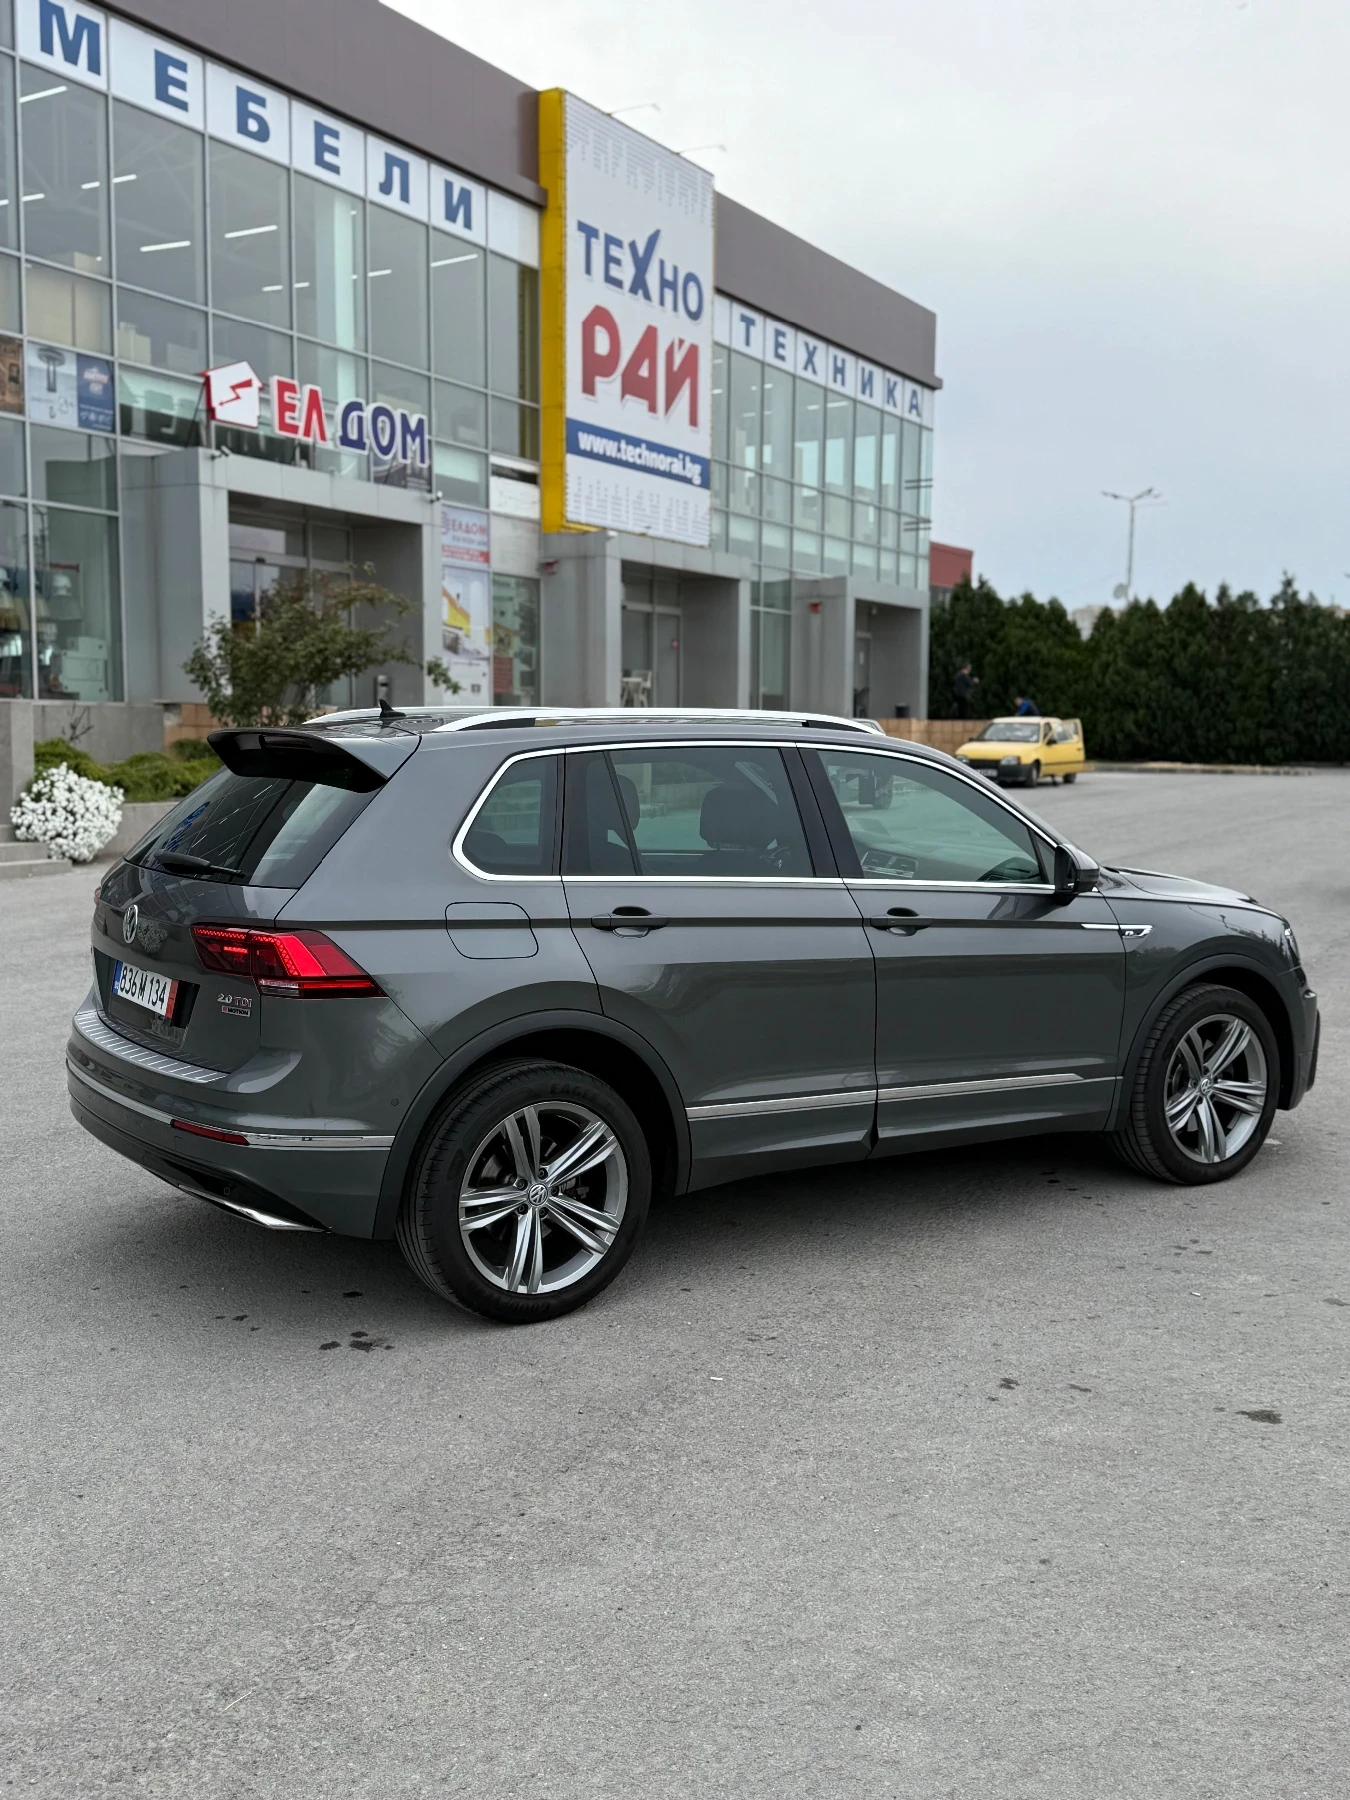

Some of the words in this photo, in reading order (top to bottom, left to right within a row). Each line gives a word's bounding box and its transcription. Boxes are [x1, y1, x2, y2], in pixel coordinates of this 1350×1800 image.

[39, 0, 473, 231] МЕБЕЛИ
[577, 220, 704, 321] ТЕХНО
[582, 304, 699, 428] РАЙ
[740, 313, 921, 418] ТЕХНИКА
[577, 430, 702, 486] www.technorai.bg
[119, 966, 139, 997] 836
[137, 973, 148, 1001] M
[147, 976, 167, 1010] 134
[233, 996, 253, 1008] TDI
